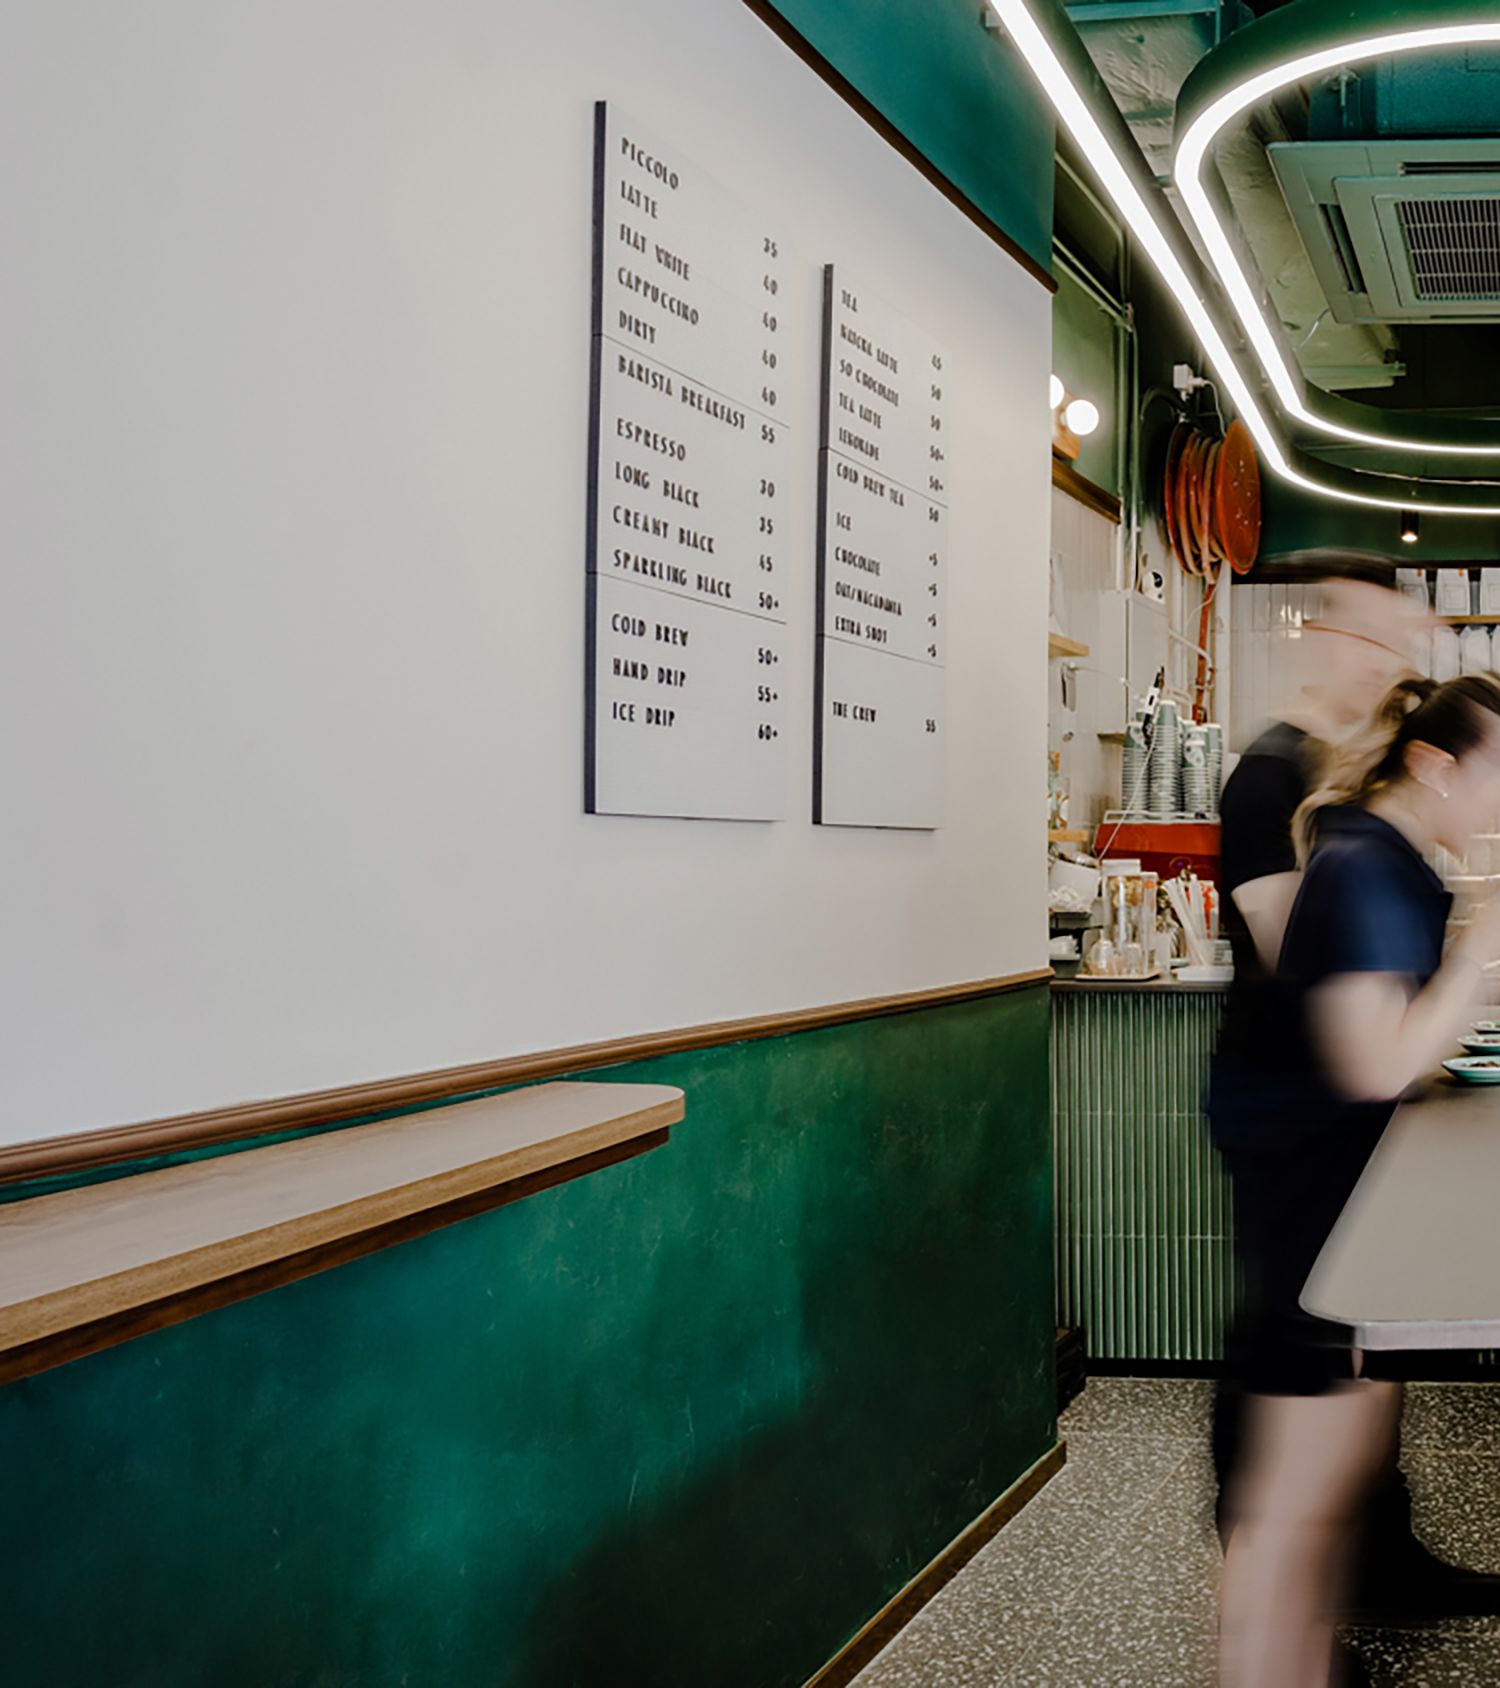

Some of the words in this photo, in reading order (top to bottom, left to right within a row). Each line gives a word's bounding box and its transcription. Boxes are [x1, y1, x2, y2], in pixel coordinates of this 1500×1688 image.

[621, 137, 679, 190] PICCOLO
[621, 181, 656, 218] LATTE
[764, 275, 777, 295] 40
[620, 224, 646, 253] FLAT
[656, 245, 688, 280] WHITE
[763, 312, 776, 332] 40
[618, 268, 699, 325] CAPPUCCINO
[762, 350, 776, 369] 40
[620, 310, 655, 343] DIRTY
[762, 387, 776, 406] 40
[619, 355, 672, 395] BARISTA
[682, 386, 744, 429] BREAKFAST
[762, 425, 774, 443] 55
[840, 392, 854, 413] TEA
[860, 404, 881, 430] LATTE
[617, 418, 685, 461] ESPRESSO
[760, 479, 774, 498] 30
[616, 462, 650, 489] LONG
[664, 480, 698, 508] BLACK
[760, 517, 773, 534] 35
[836, 512, 851, 532] ICE
[837, 462, 858, 484] COLD
[863, 475, 884, 497] BREW
[890, 488, 904, 507] TEA
[929, 507, 938, 522] 50
[613, 506, 668, 538] CREAMY
[679, 528, 713, 553] BLACK
[760, 555, 772, 572] 45
[836, 546, 880, 576] CHOCOLATE
[614, 550, 686, 586] SPARKLING
[697, 574, 731, 598] BLACK
[759, 592, 778, 610] 50+
[612, 614, 646, 636] COLD
[656, 624, 688, 646] BREW
[758, 648, 778, 665] 50+
[836, 616, 862, 636] EXTRA
[866, 625, 887, 644] SHOT
[614, 658, 648, 680] HAND
[658, 667, 685, 687] DRIP
[758, 686, 777, 702] 55+
[613, 702, 634, 722] ICE
[646, 708, 674, 726] DRIP
[758, 725, 777, 740] 60+
[833, 701, 848, 718] THE
[853, 705, 876, 722] CREW
[926, 719, 936, 733] 55
